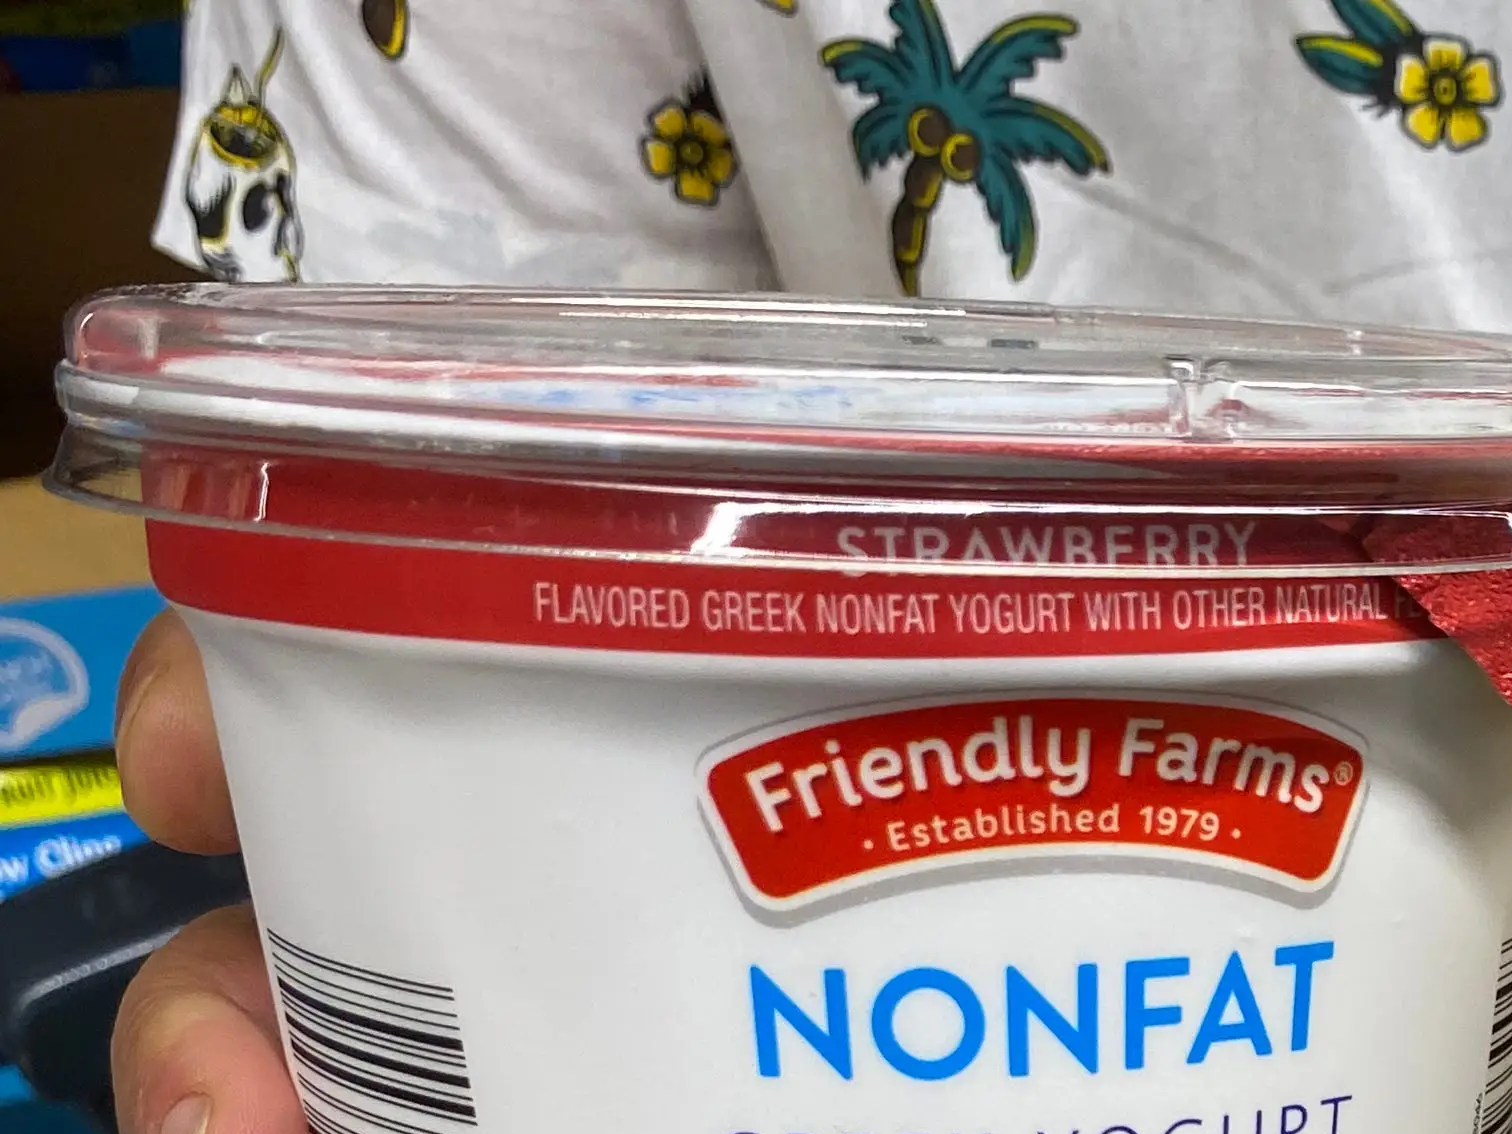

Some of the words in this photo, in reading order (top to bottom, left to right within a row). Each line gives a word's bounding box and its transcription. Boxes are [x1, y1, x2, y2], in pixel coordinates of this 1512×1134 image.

[837, 520, 1257, 576] STRAWBERRY
[534, 582, 690, 629] FLAVORED
[702, 590, 806, 633] GREEK
[816, 593, 938, 634] NONFAT
[948, 592, 1074, 634] YOGURT
[1084, 589, 1161, 631] WITH
[1172, 587, 1265, 630] OTHER
[1276, 582, 1388, 624] NATURAL
[746, 715, 1092, 832] Friendly
[887, 804, 1119, 851] Established
[1139, 806, 1220, 840] 1979
[750, 941, 1335, 1081] NONFAT
